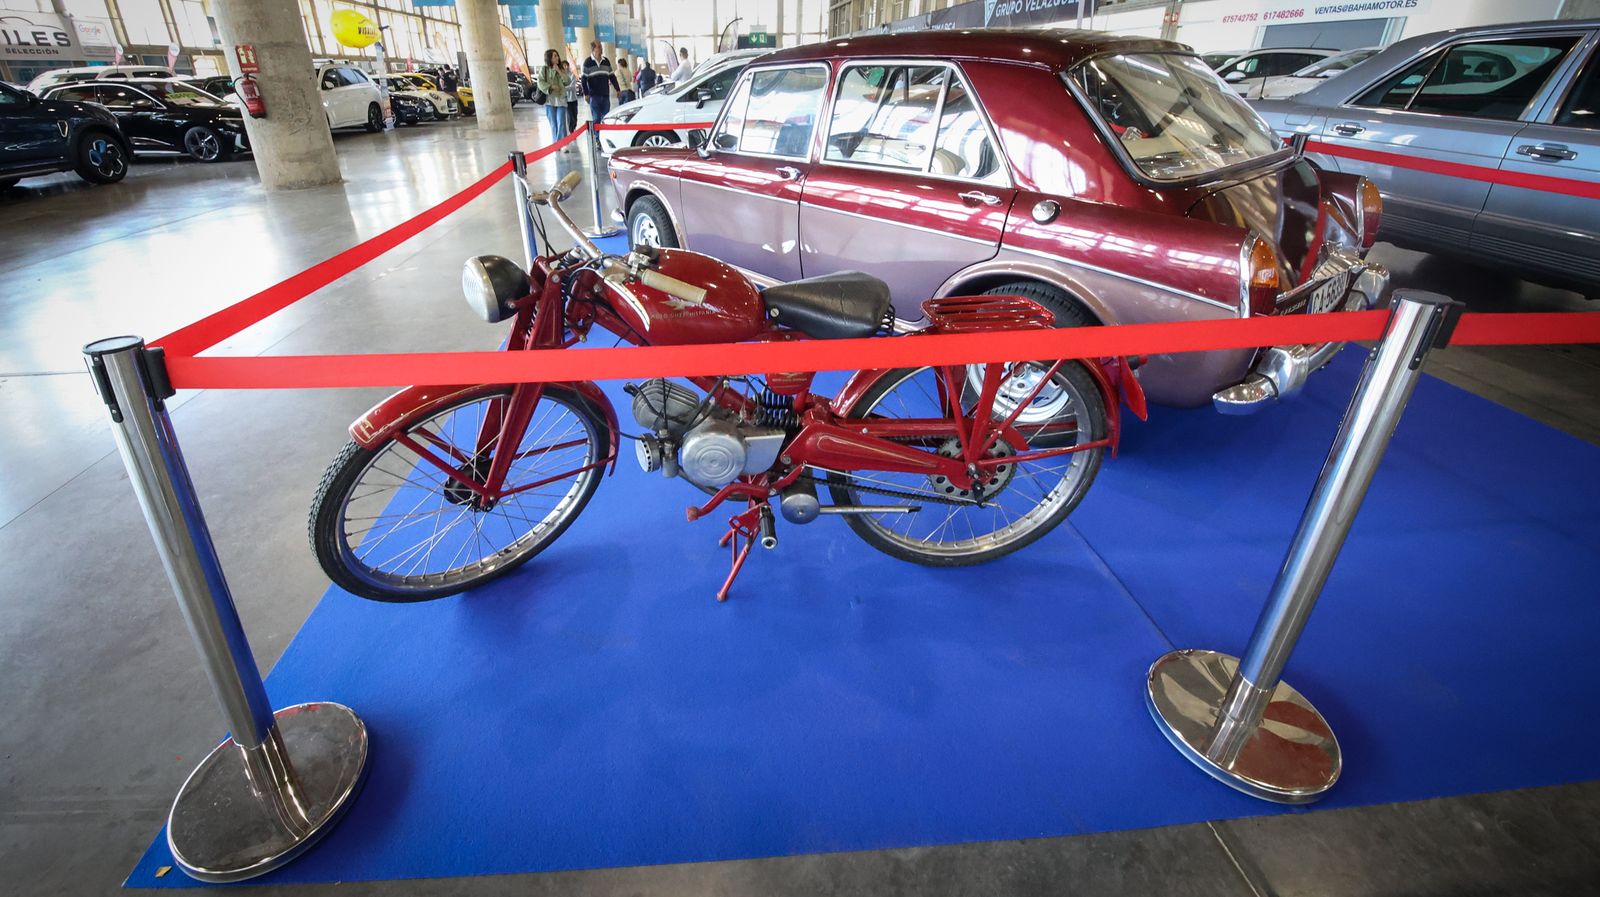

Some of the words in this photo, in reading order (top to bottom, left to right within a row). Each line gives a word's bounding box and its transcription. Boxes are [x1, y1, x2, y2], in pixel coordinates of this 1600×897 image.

[995, 2, 1023, 17] GRUPO
[1263, 9, 1305, 20] 617482666
[1314, 0, 1418, 15] VENTAS@BAHIAMOTOR.ES
